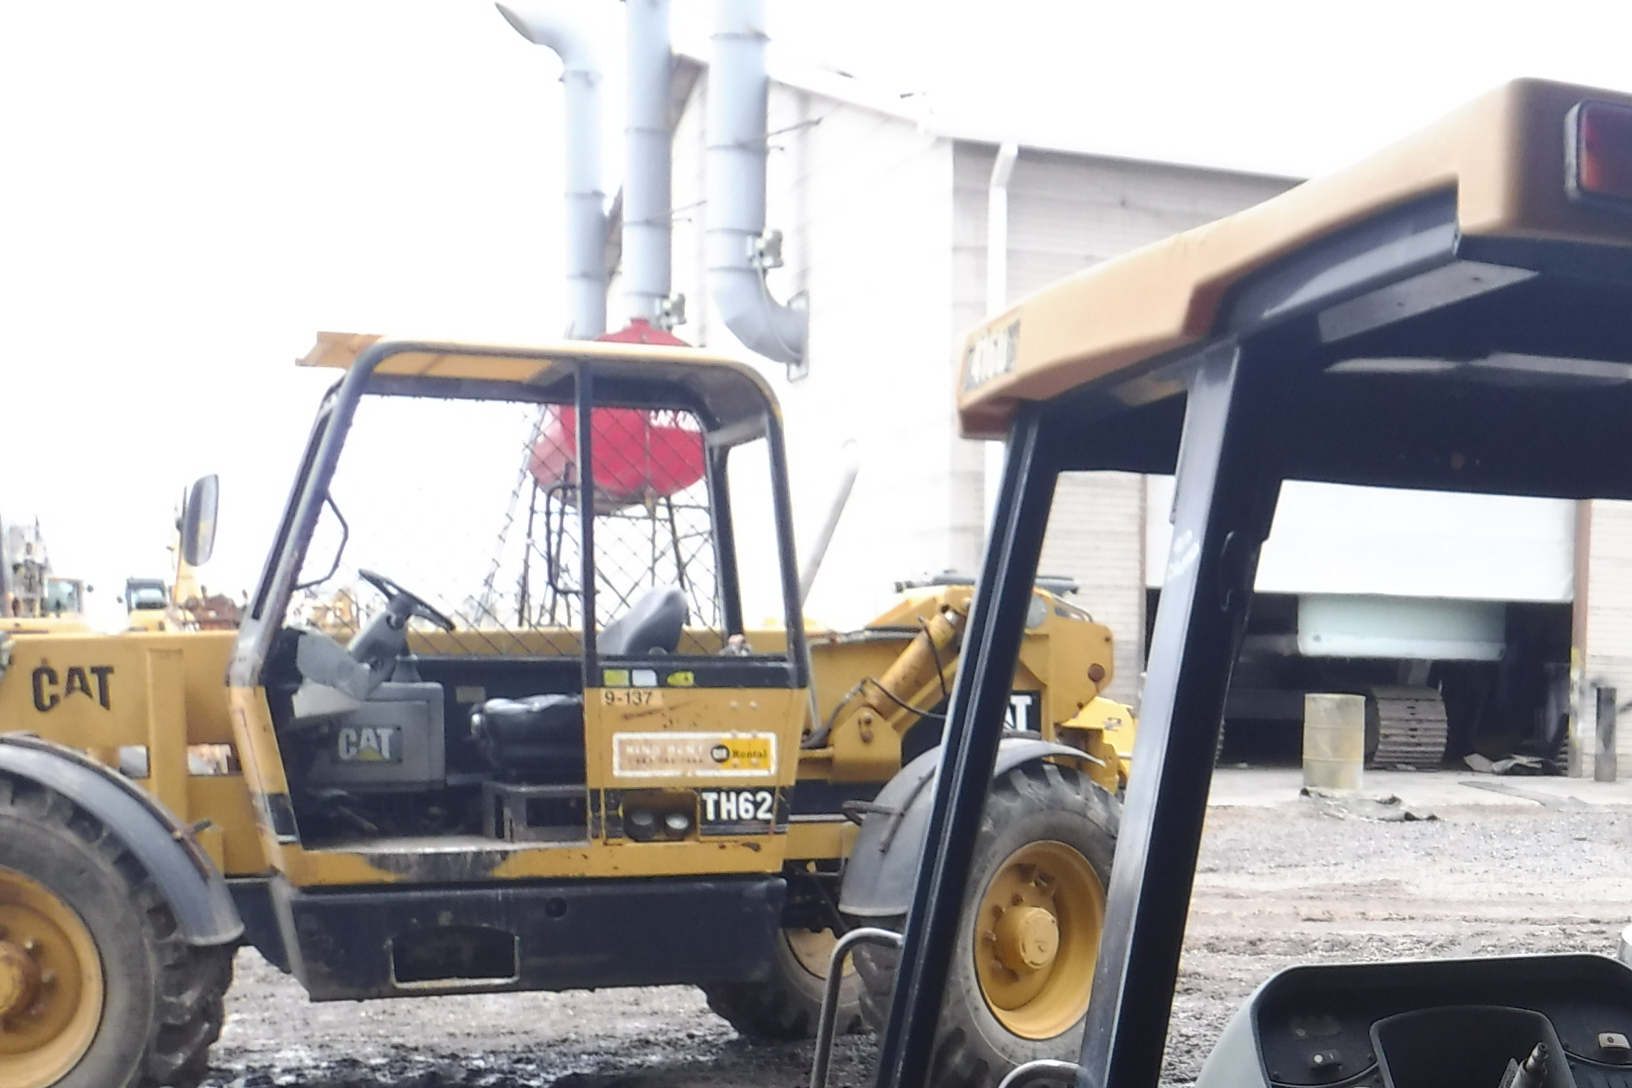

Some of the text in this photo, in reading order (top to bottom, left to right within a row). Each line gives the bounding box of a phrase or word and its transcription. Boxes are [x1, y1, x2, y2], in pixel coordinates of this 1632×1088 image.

[32, 665, 114, 712] CAT
[604, 690, 652, 705] 9-137
[338, 727, 394, 760] CAT
[732, 748, 768, 759] Rental
[701, 790, 774, 821] TH62
